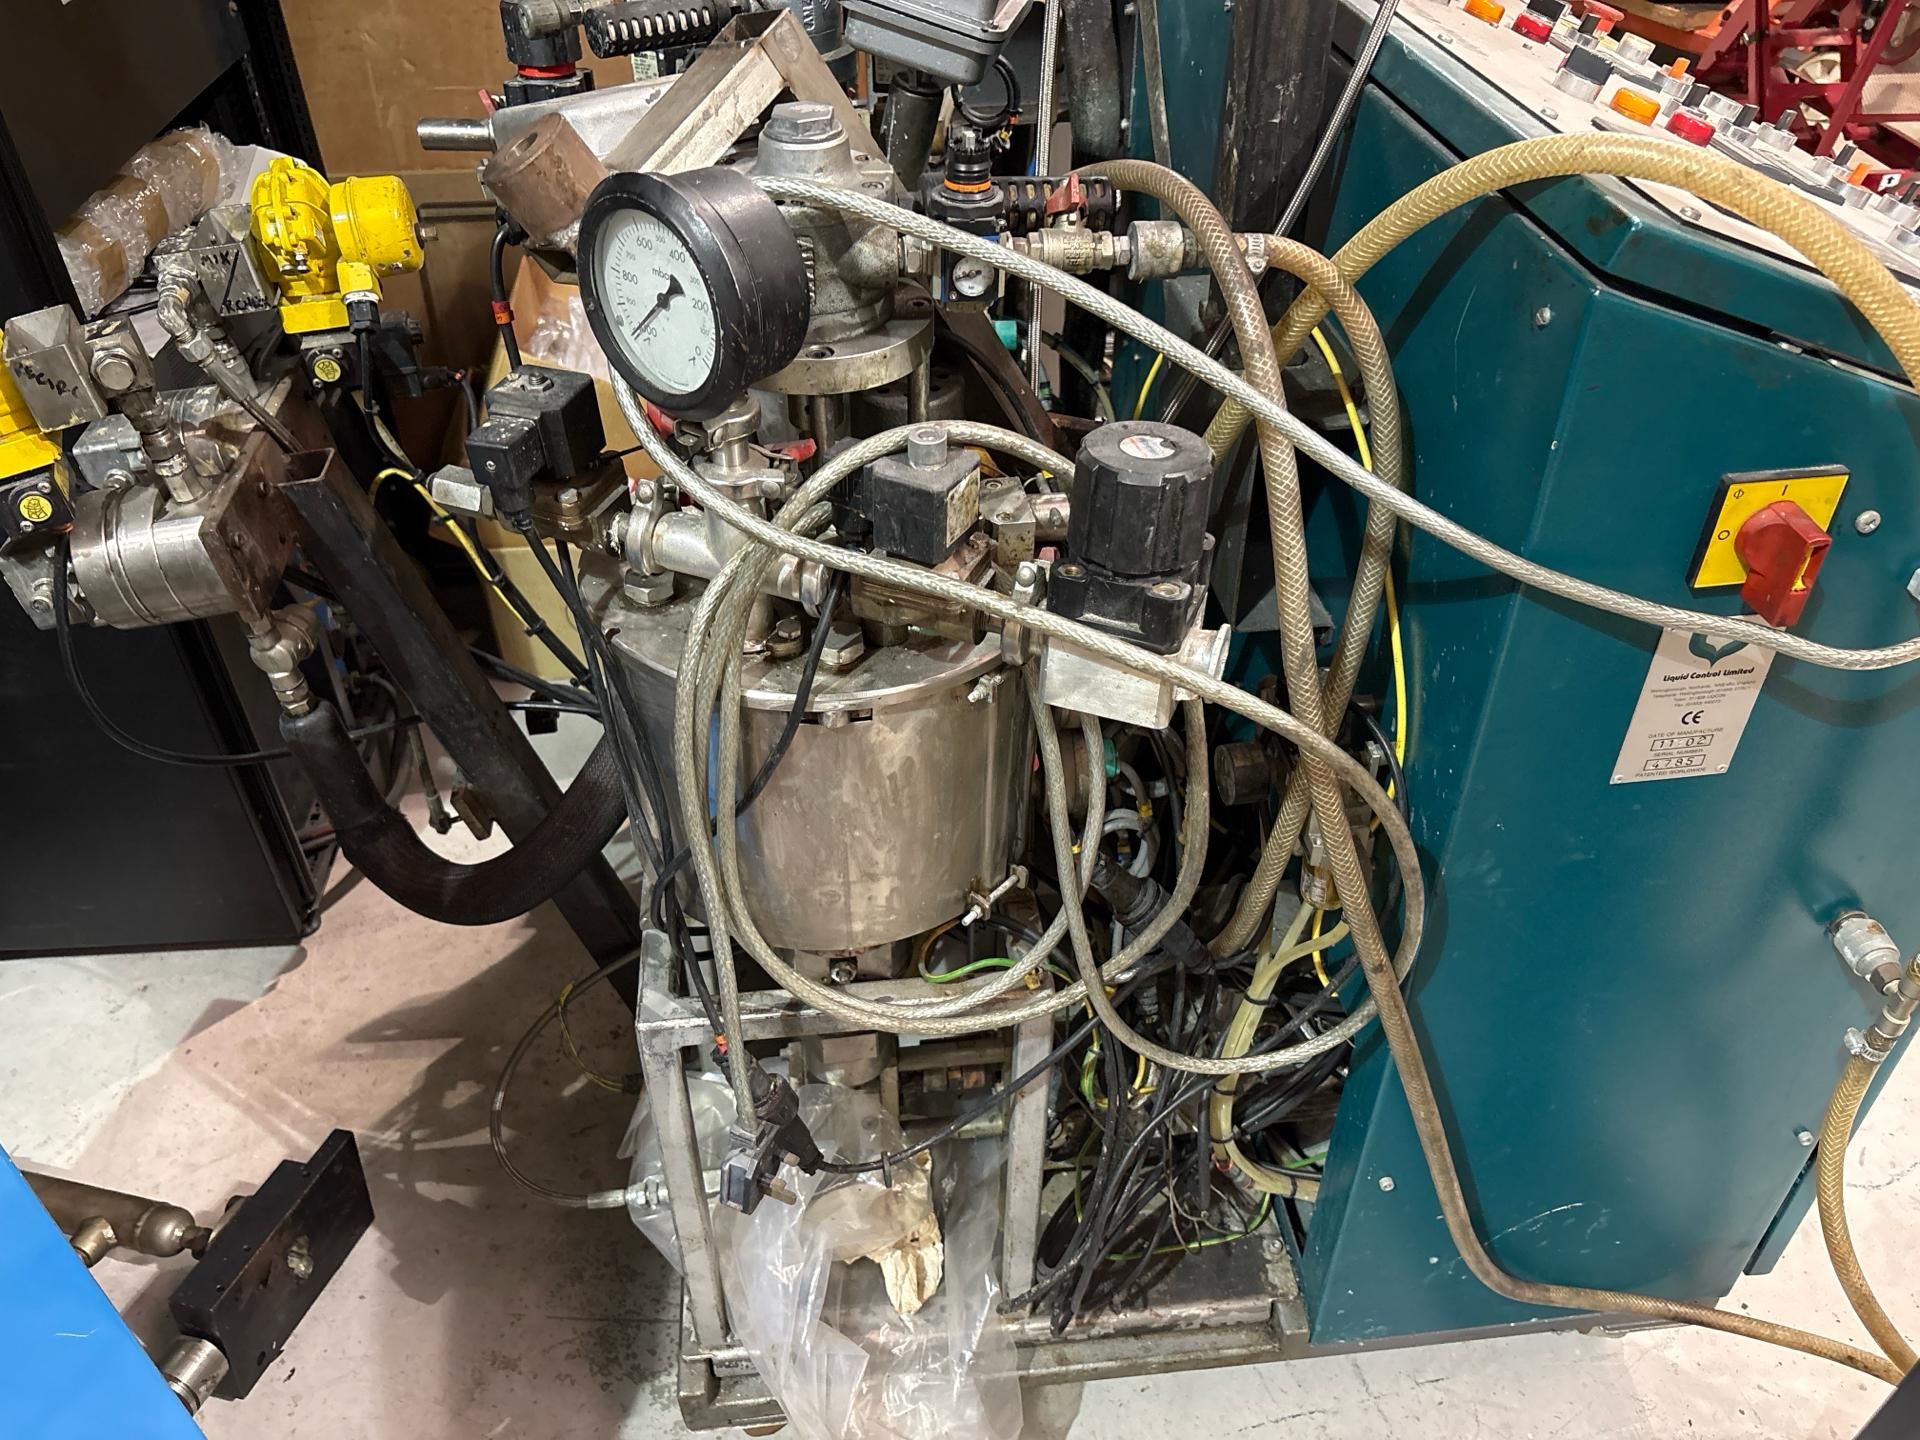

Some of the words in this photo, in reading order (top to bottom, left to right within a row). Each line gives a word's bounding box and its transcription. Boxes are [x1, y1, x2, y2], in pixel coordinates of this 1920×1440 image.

[636, 236, 652, 250] 600
[201, 250, 231, 266] MIX
[670, 250, 686, 263] 400
[622, 270, 638, 285] 800
[652, 267, 670, 280] mba
[692, 298, 709, 316] 200
[695, 346, 702, 356] 0
[1663, 672, 1689, 682] Liquid
[1690, 670, 1721, 680] Control
[1723, 667, 1755, 676] Limited
